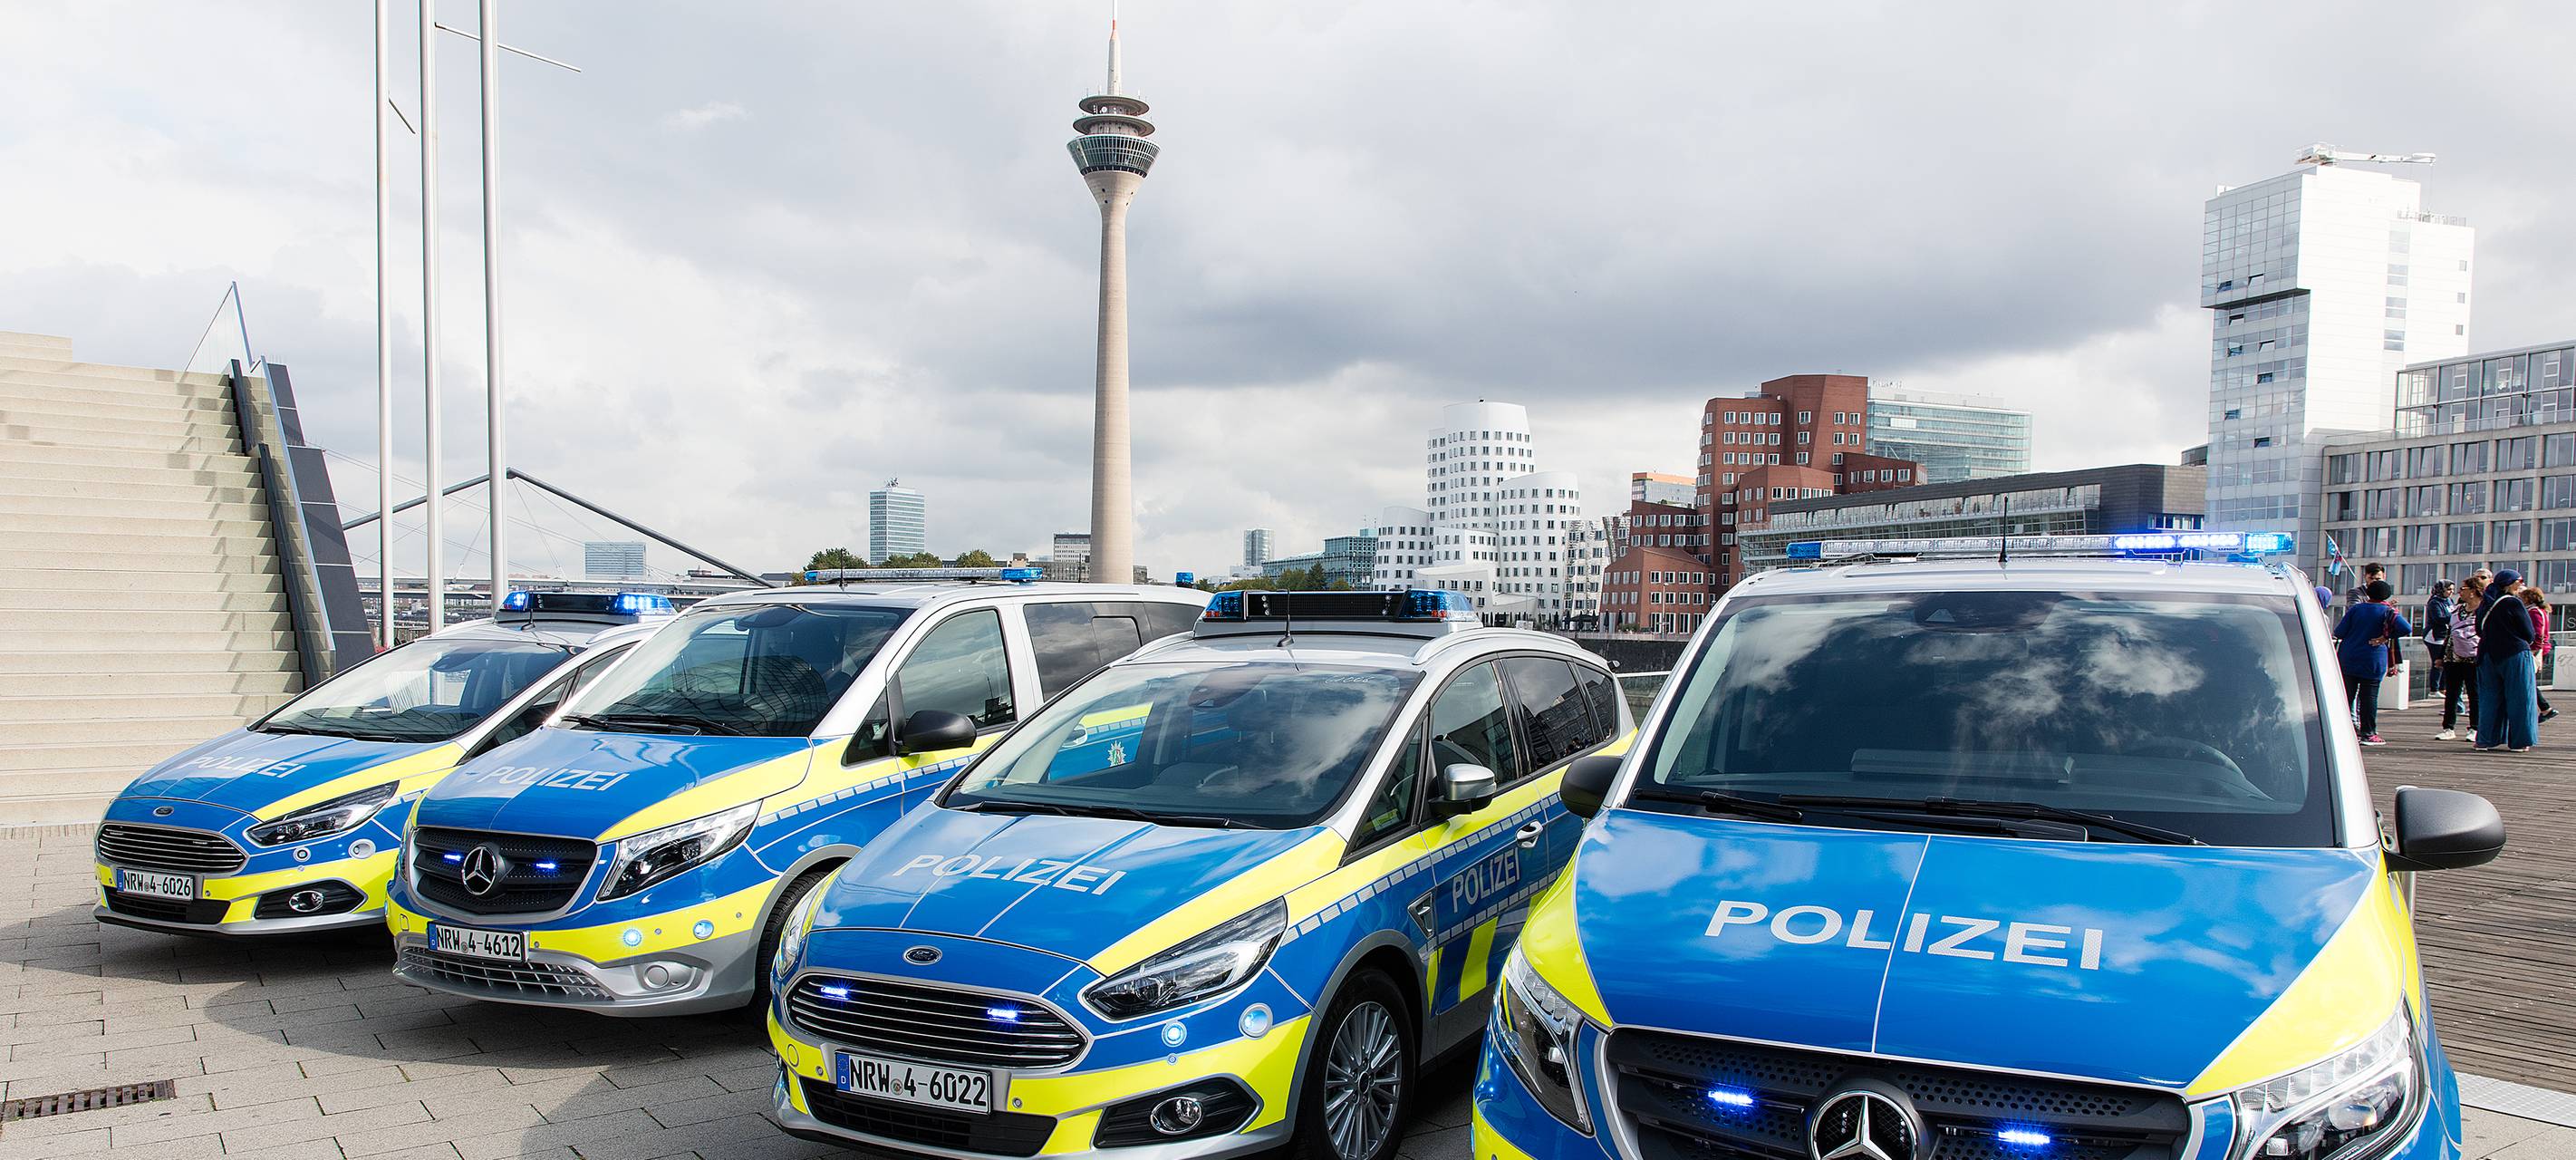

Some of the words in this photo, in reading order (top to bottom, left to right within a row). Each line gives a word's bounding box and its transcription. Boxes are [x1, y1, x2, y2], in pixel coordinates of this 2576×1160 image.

[178, 756, 307, 778] POLIZEI
[477, 766, 630, 791] POLIZEI
[892, 854, 1127, 895] POLIZEI
[1452, 846, 1520, 914] POLIZEI
[1704, 900, 2103, 971] POLIZEI
[841, 1075, 847, 1084] D
